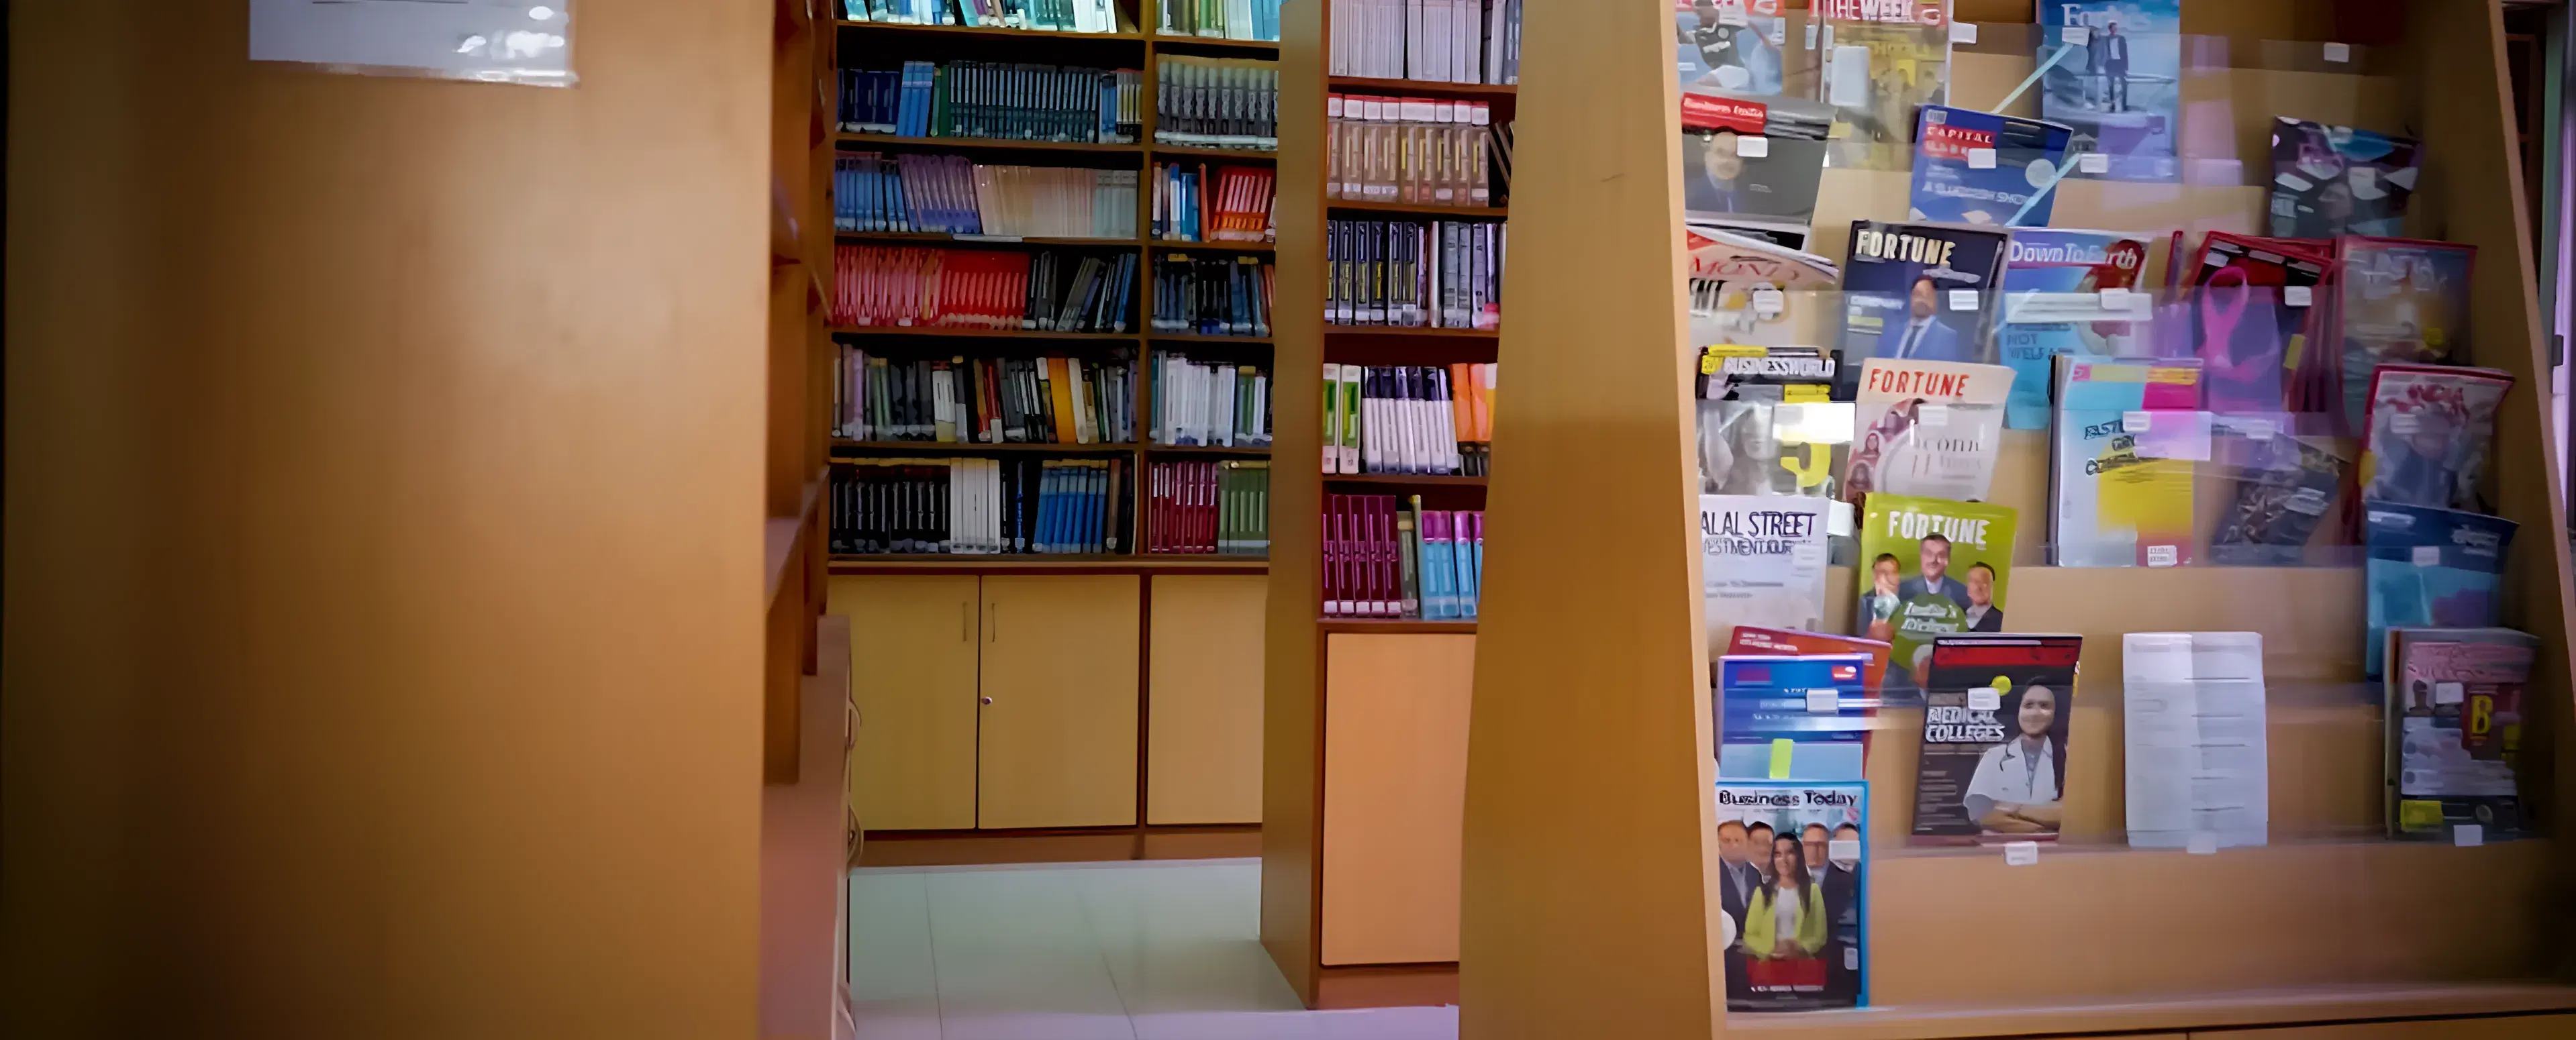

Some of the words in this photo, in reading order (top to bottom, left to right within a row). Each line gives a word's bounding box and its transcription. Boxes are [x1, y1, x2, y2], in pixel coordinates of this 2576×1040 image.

[1827, 0, 1860, 20] THE
[1861, 0, 1916, 22] WEEK
[1926, 126, 1993, 144] CAPITAL
[1856, 229, 1956, 264] FORTUNE
[1868, 368, 1970, 397] FORTUNE
[1701, 511, 1743, 535] ALAL
[1748, 511, 1817, 537] STREET
[1889, 511, 1991, 544] FORTUNE
[1926, 725, 2005, 742] COLLEGES
[1719, 790, 1800, 807] Business
[1804, 789, 1857, 807] Today
